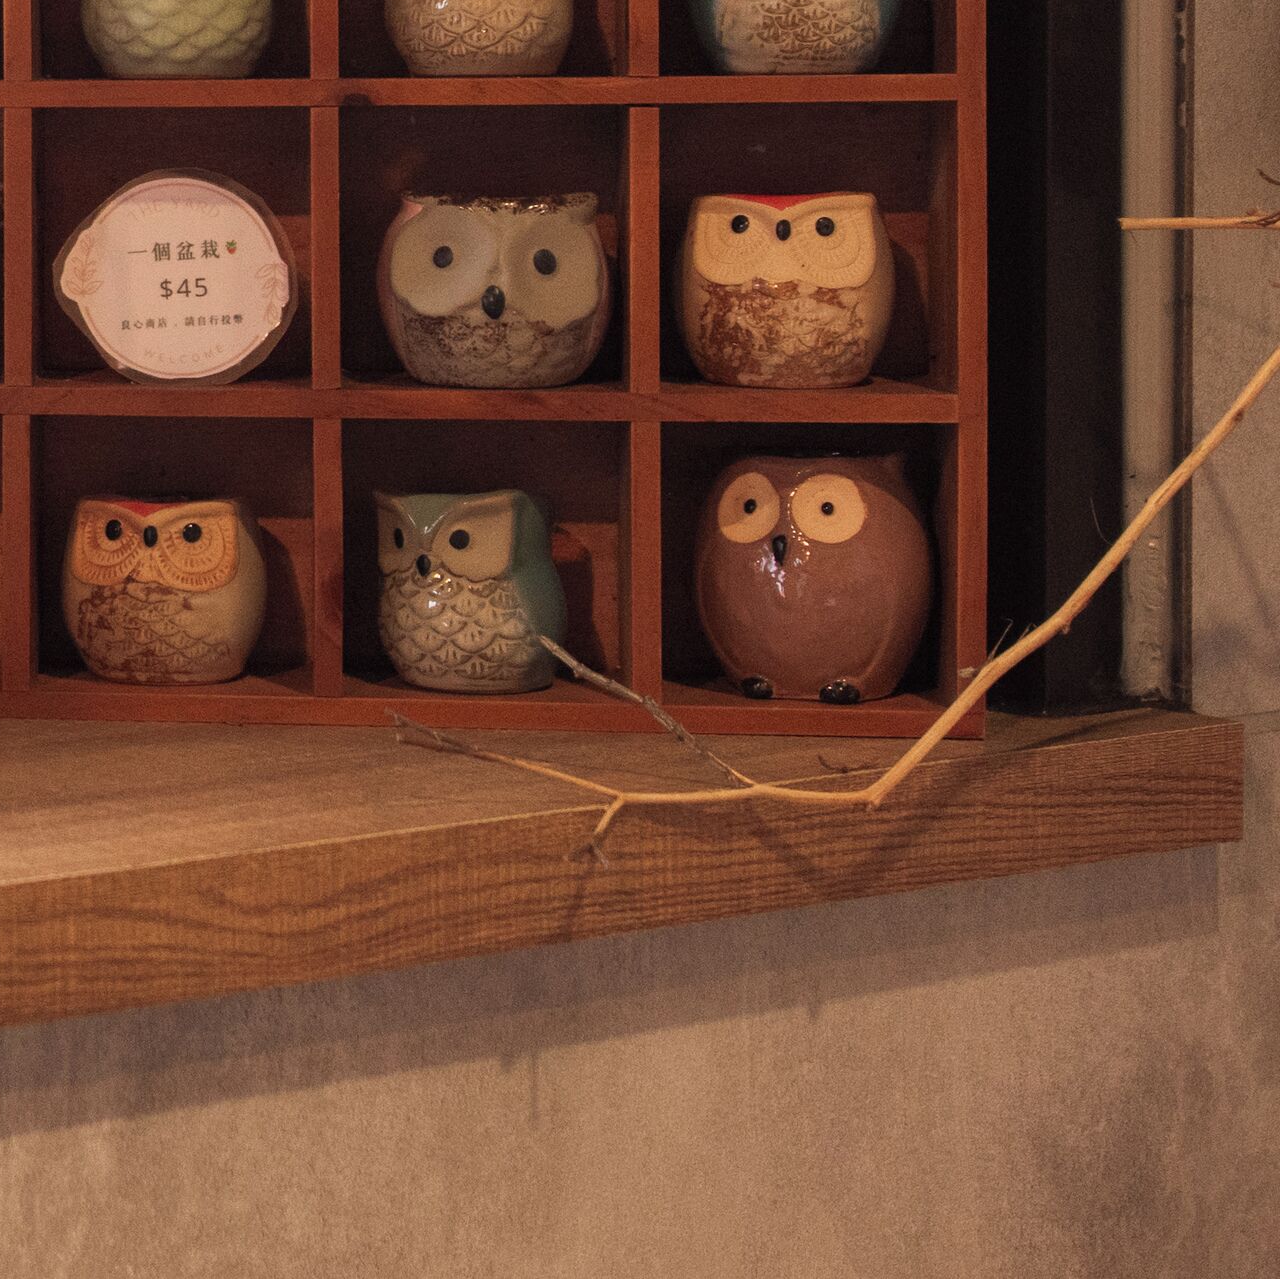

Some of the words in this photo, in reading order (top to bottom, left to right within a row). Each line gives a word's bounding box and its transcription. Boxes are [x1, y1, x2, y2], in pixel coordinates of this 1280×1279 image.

[127, 239, 220, 262] 一個盆栽
[160, 277, 208, 300] $45
